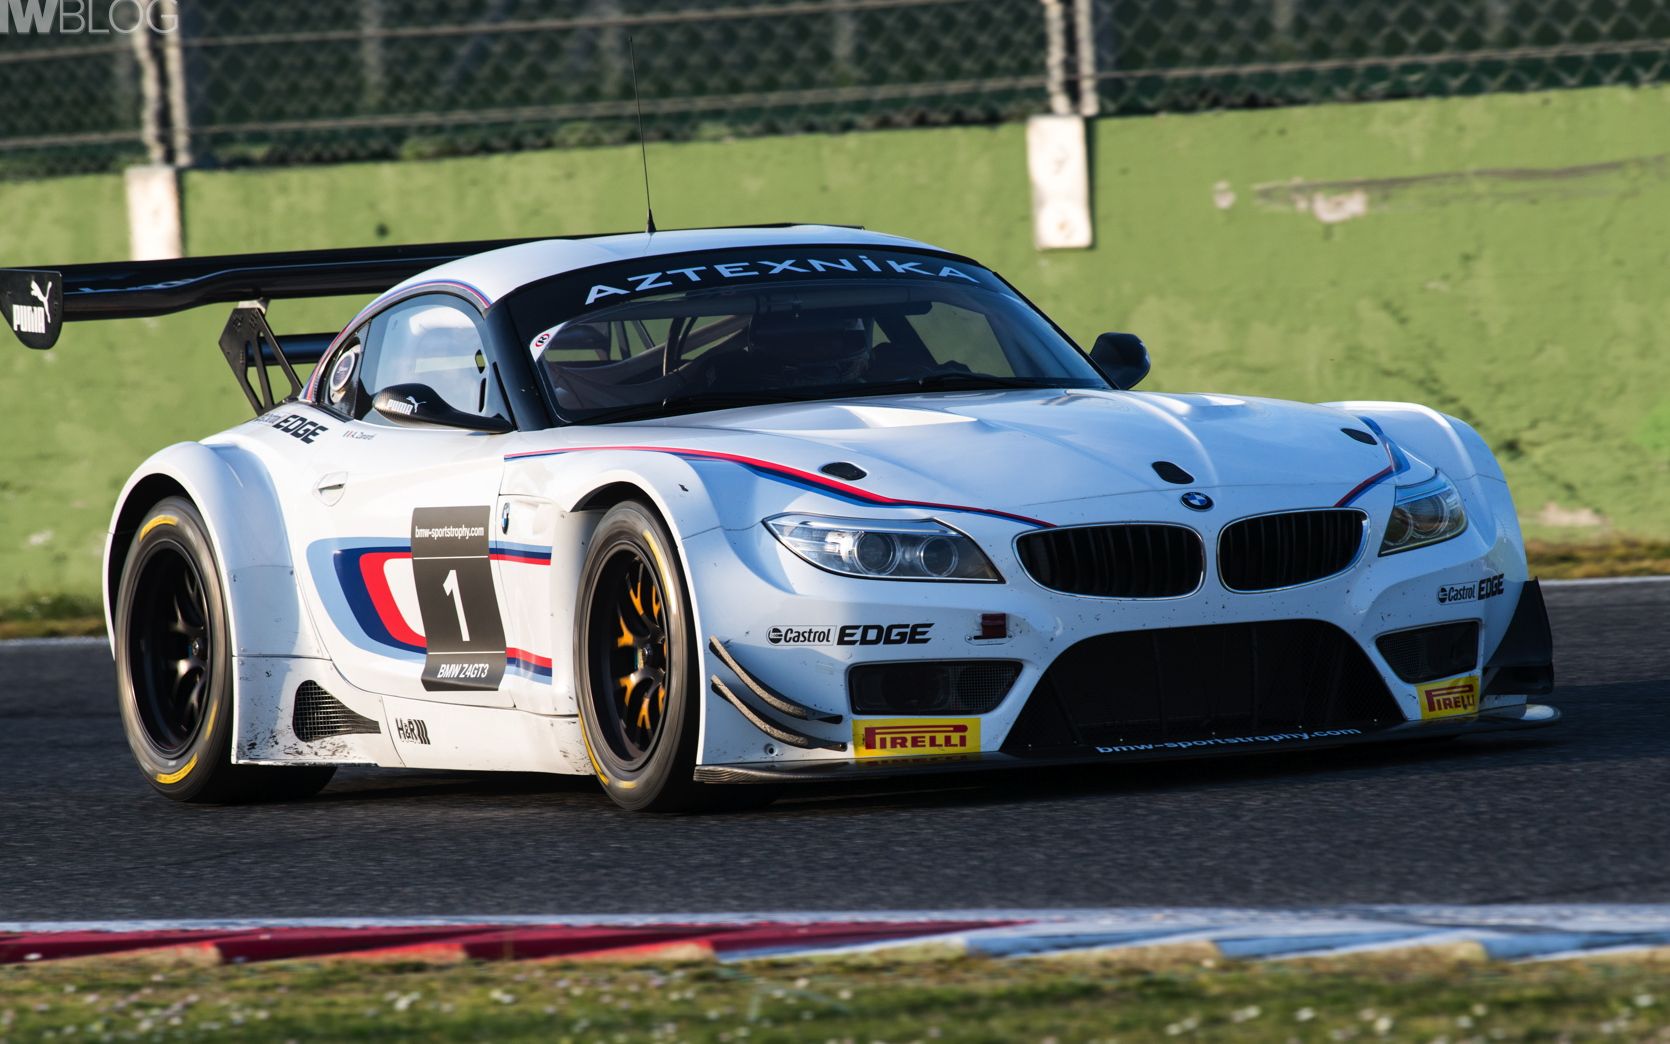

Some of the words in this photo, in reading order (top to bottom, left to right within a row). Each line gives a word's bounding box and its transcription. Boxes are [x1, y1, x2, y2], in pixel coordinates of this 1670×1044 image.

[12, 304, 46, 333] PUMA
[387, 399, 413, 416] PUMA
[272, 414, 329, 444] EDGE
[415, 525, 484, 540] bmw-sportstrophy.com
[1448, 585, 1475, 602] Castrol
[1478, 574, 1504, 600] EDGE
[443, 569, 470, 641] 1
[784, 628, 831, 643] Castrol
[837, 623, 935, 646] EDGE
[437, 664, 460, 679] BMW
[459, 663, 489, 678] Z4GT3
[1425, 684, 1474, 712] PIRELLI
[395, 718, 418, 740] H&R
[864, 725, 968, 749] PIRELLI
[1096, 727, 1361, 753] bmw-sportstrophy.com
